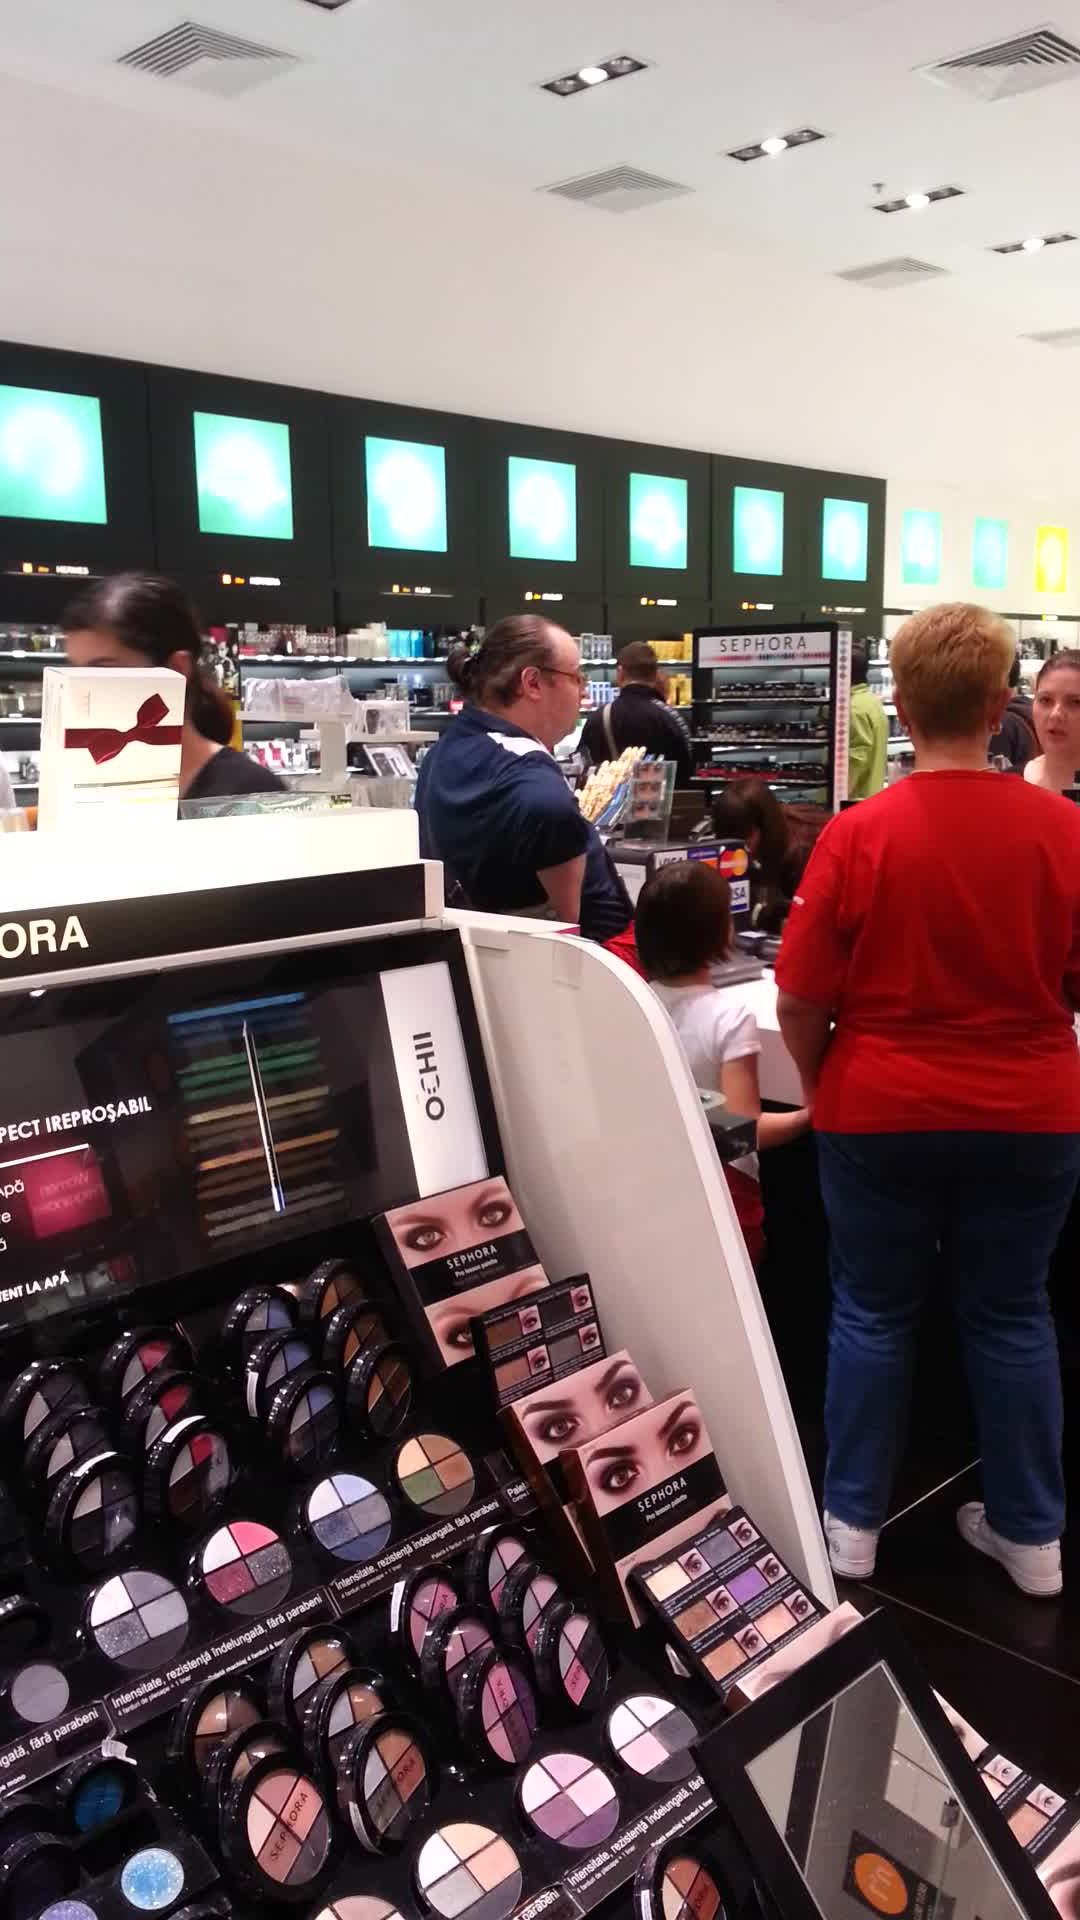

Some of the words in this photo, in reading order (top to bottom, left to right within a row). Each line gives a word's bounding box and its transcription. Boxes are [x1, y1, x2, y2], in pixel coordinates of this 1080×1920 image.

[719, 635, 807, 653] SEPHORA
[0, 915, 89, 959] ORA
[446, 1243, 498, 1270] SEPHORA
[25, 1280, 42, 1295] LA
[44, 1269, 70, 1290] APĂ
[637, 1476, 687, 1513] SEPHORA
[111, 1677, 166, 1709] Intensitate,
[266, 1612, 285, 1629] fără
[285, 1593, 323, 1622] parabeni
[29, 1730, 53, 1750] fără
[53, 1706, 99, 1741] parabeni
[567, 1851, 614, 1887] Intensitate,
